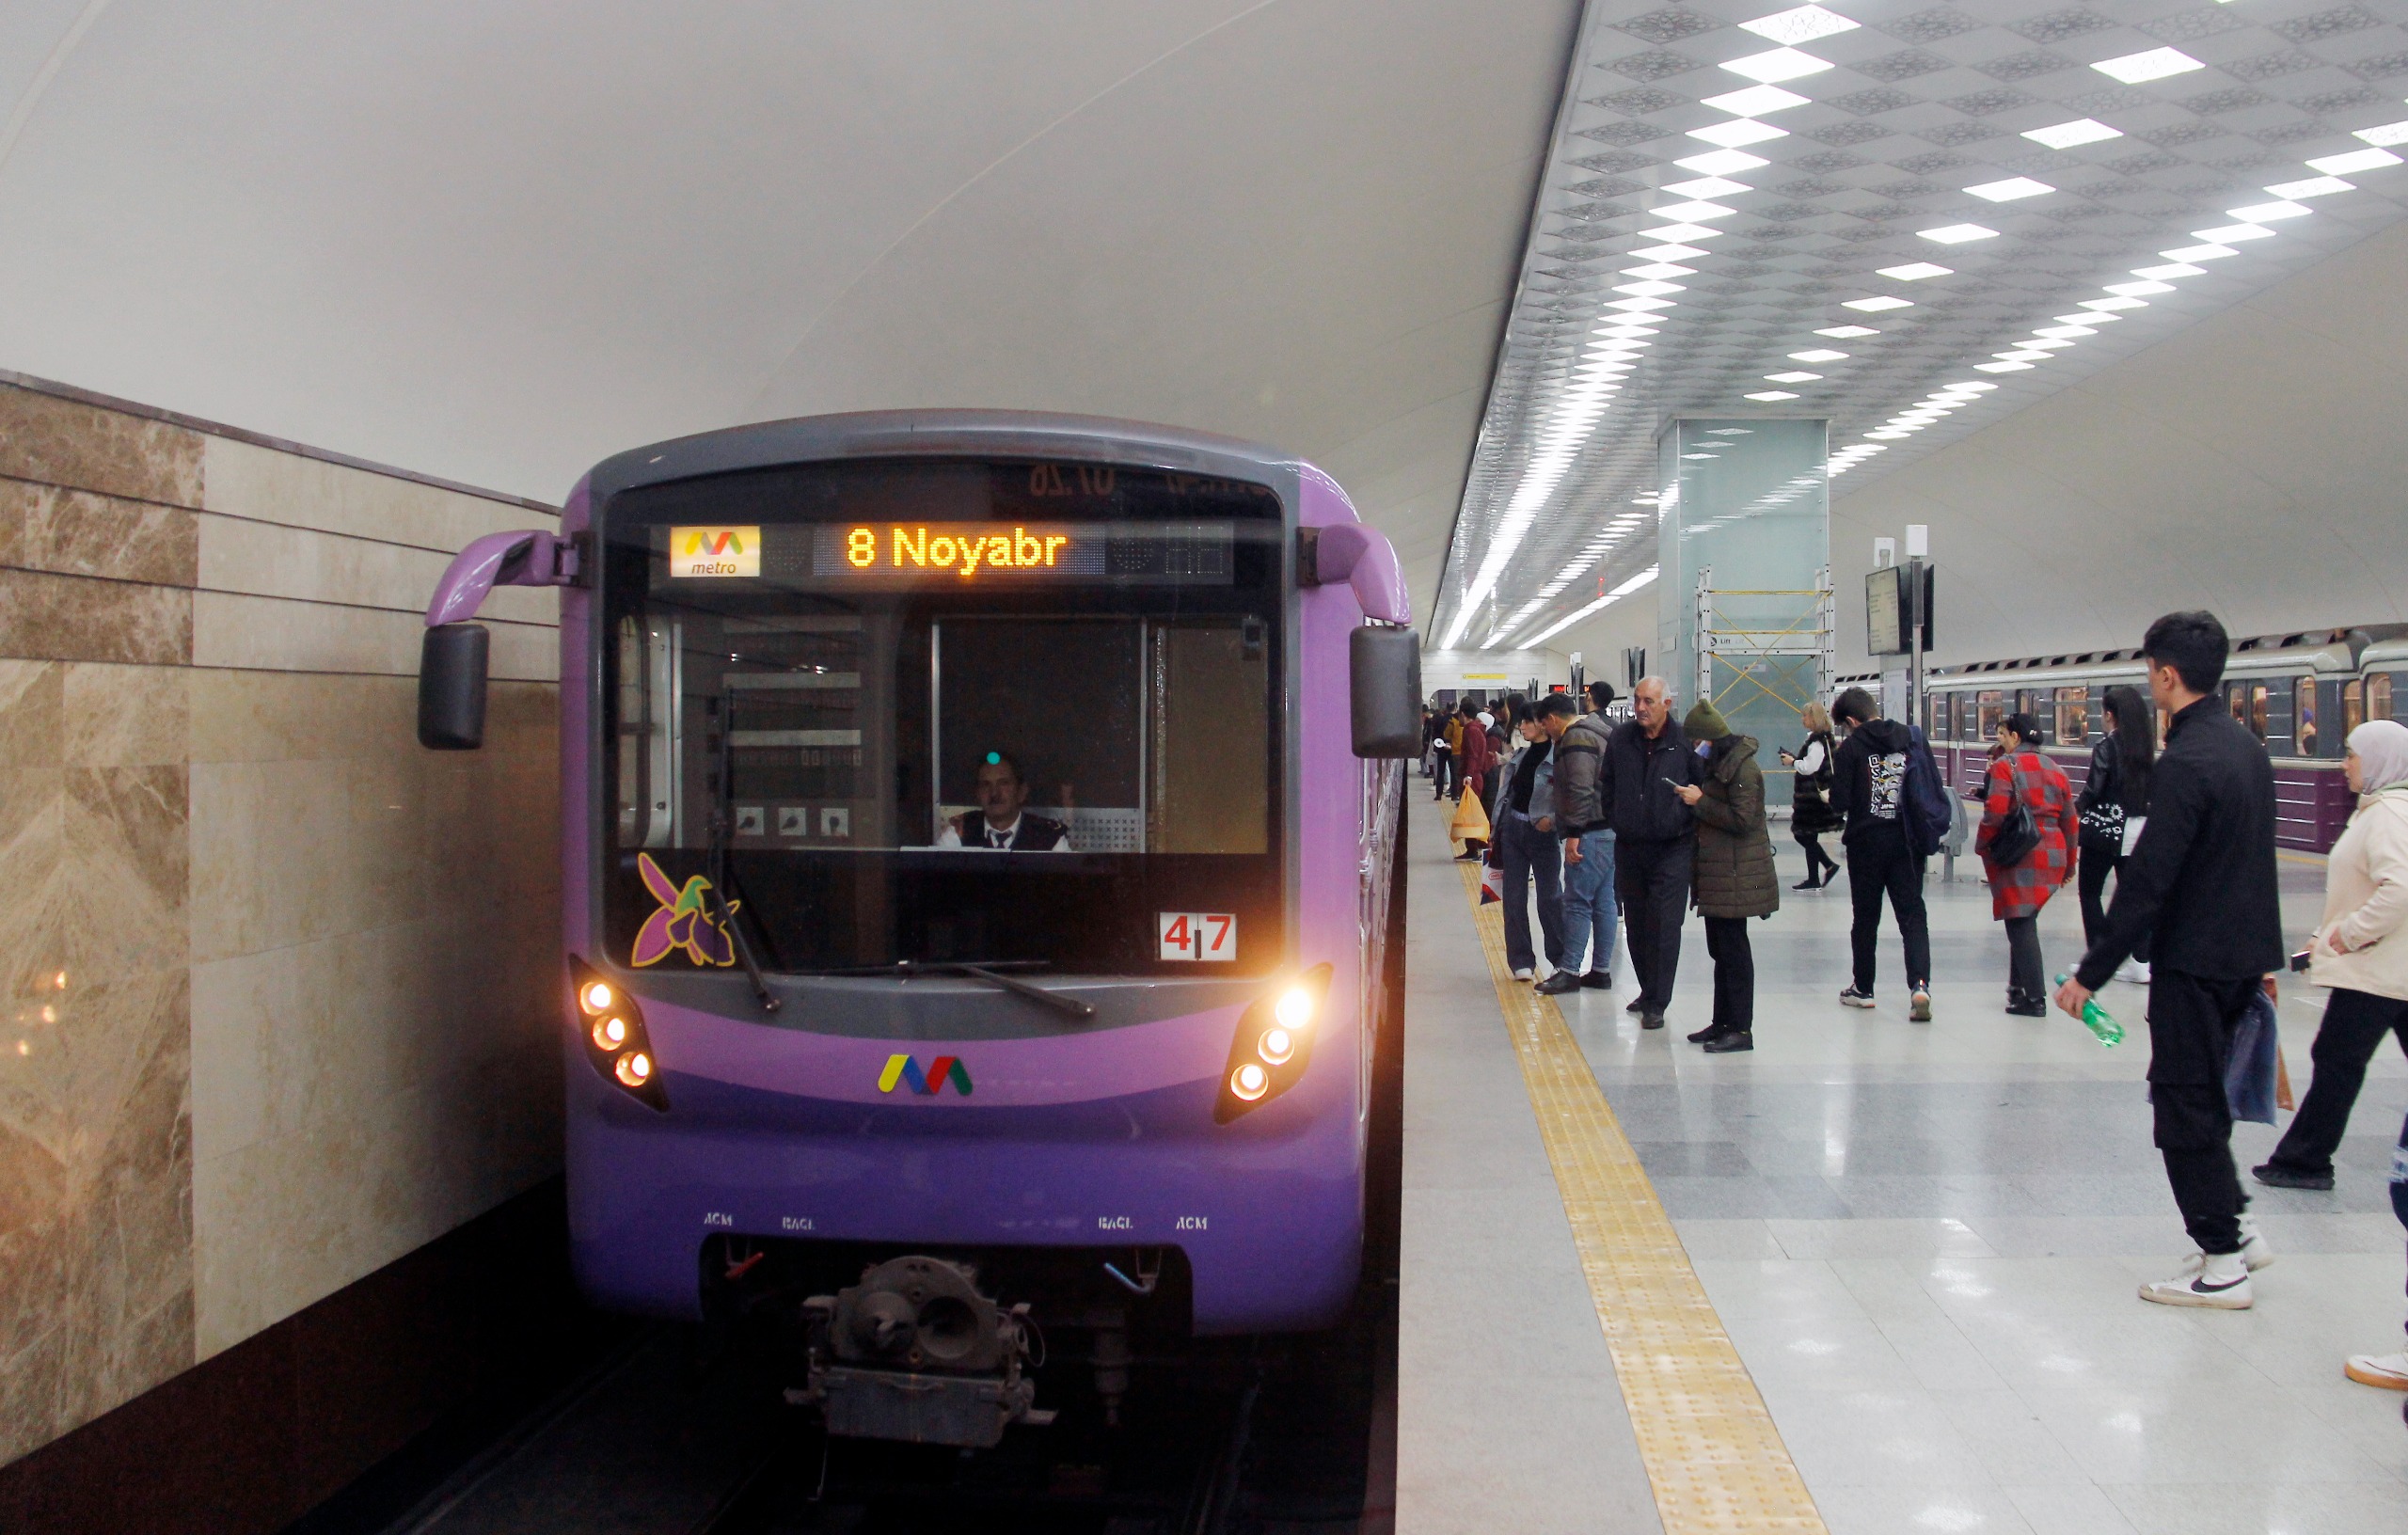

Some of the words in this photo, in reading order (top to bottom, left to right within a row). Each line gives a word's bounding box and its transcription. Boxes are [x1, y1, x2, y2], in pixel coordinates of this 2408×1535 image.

[848, 528, 875, 566] 8
[894, 527, 1067, 576] Noyabr
[691, 562, 737, 574] metro
